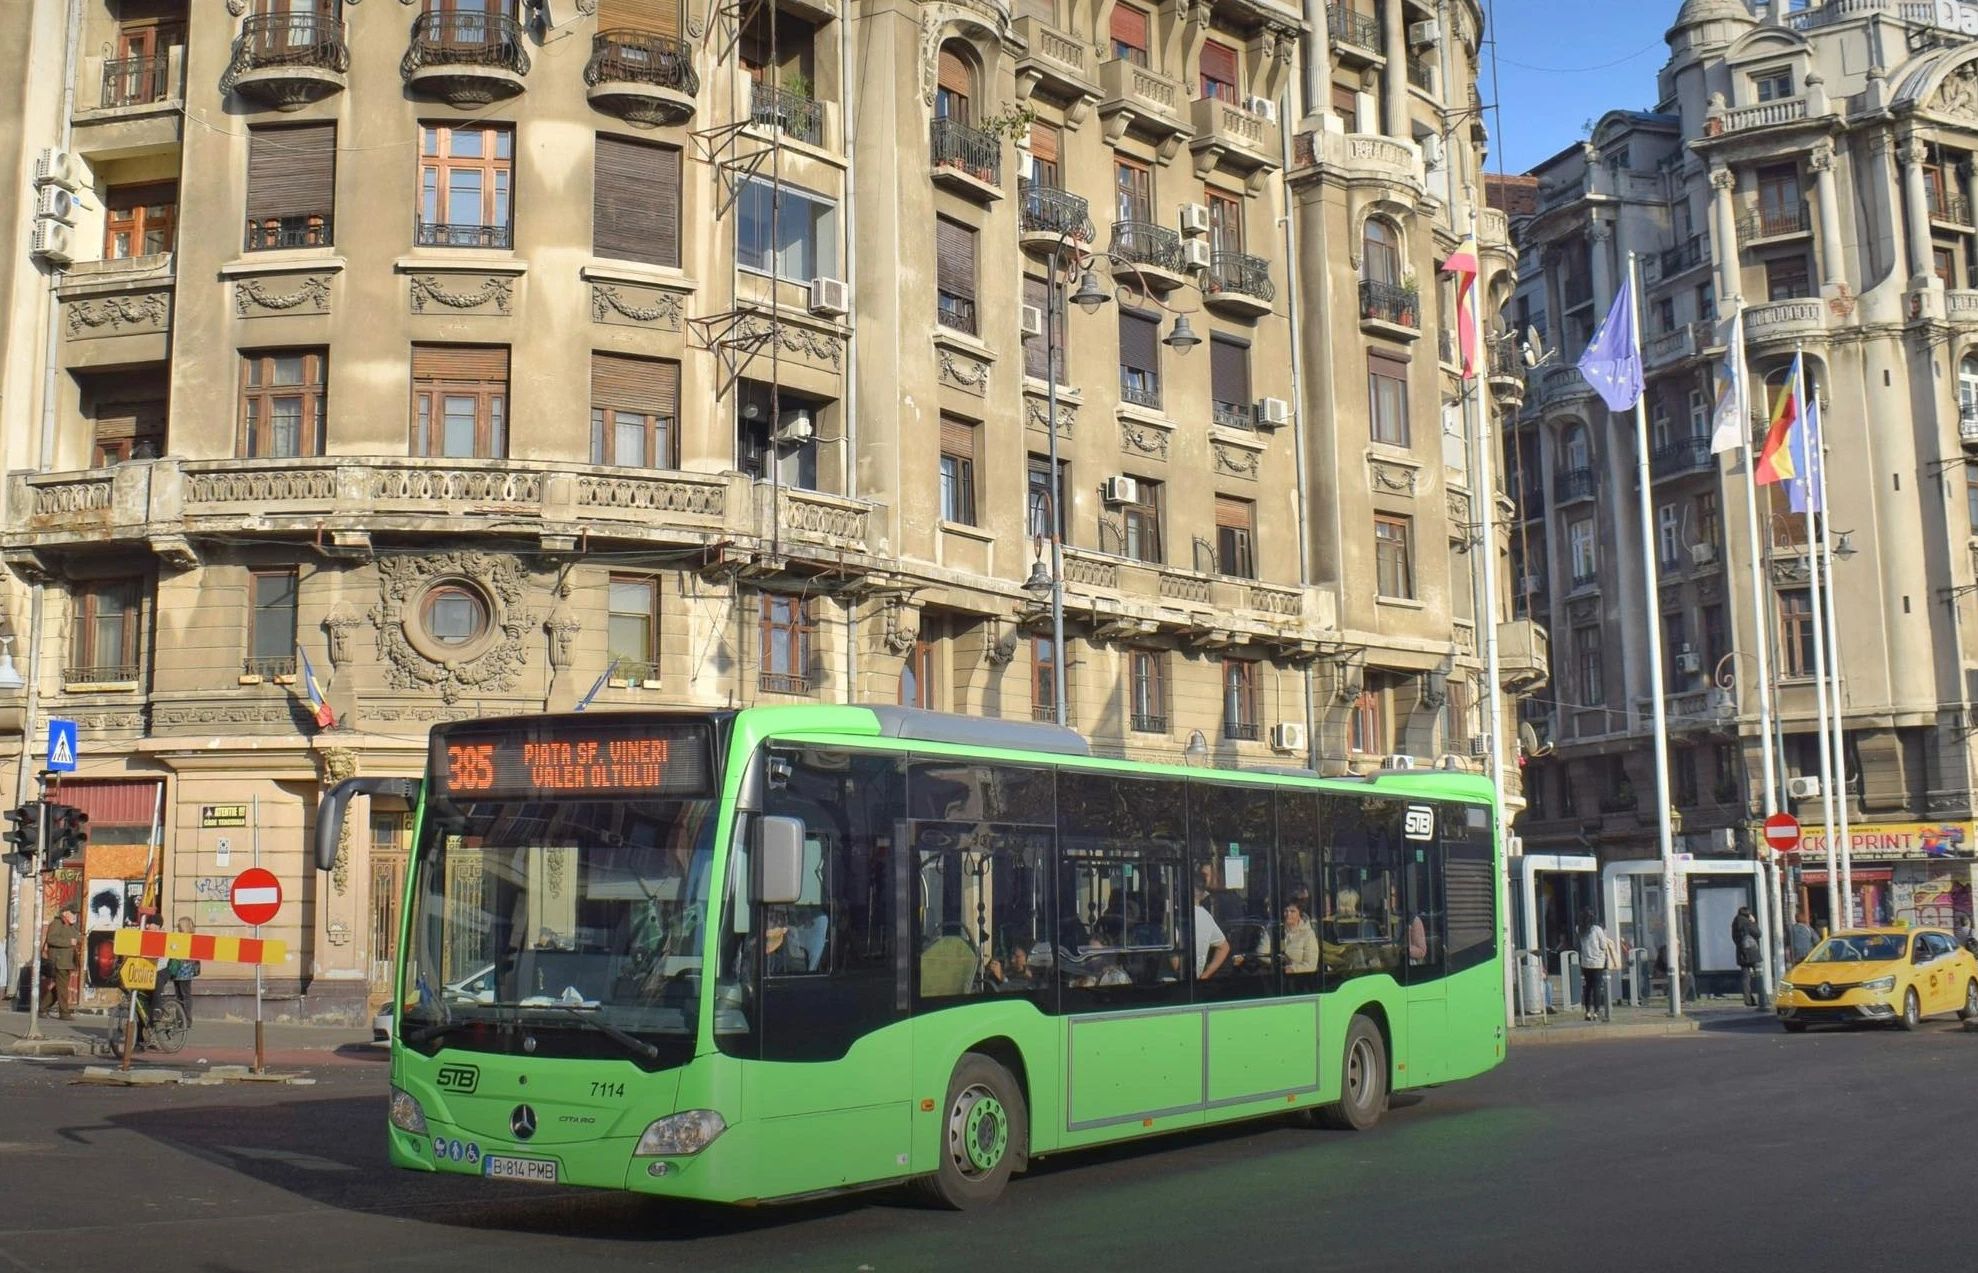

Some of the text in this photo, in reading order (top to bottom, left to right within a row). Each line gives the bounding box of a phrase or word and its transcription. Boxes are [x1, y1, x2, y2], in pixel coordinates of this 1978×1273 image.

[524, 739, 669, 765] PIATA SF. VINERI
[447, 744, 495, 790] 385
[532, 763, 661, 788] VALEA OLTULUI
[1405, 811, 1431, 834] STB
[1853, 833, 1912, 850] PRINT
[436, 1067, 475, 1088] STB
[591, 1082, 624, 1098] 7114
[494, 1158, 554, 1179] B 814 PMB
